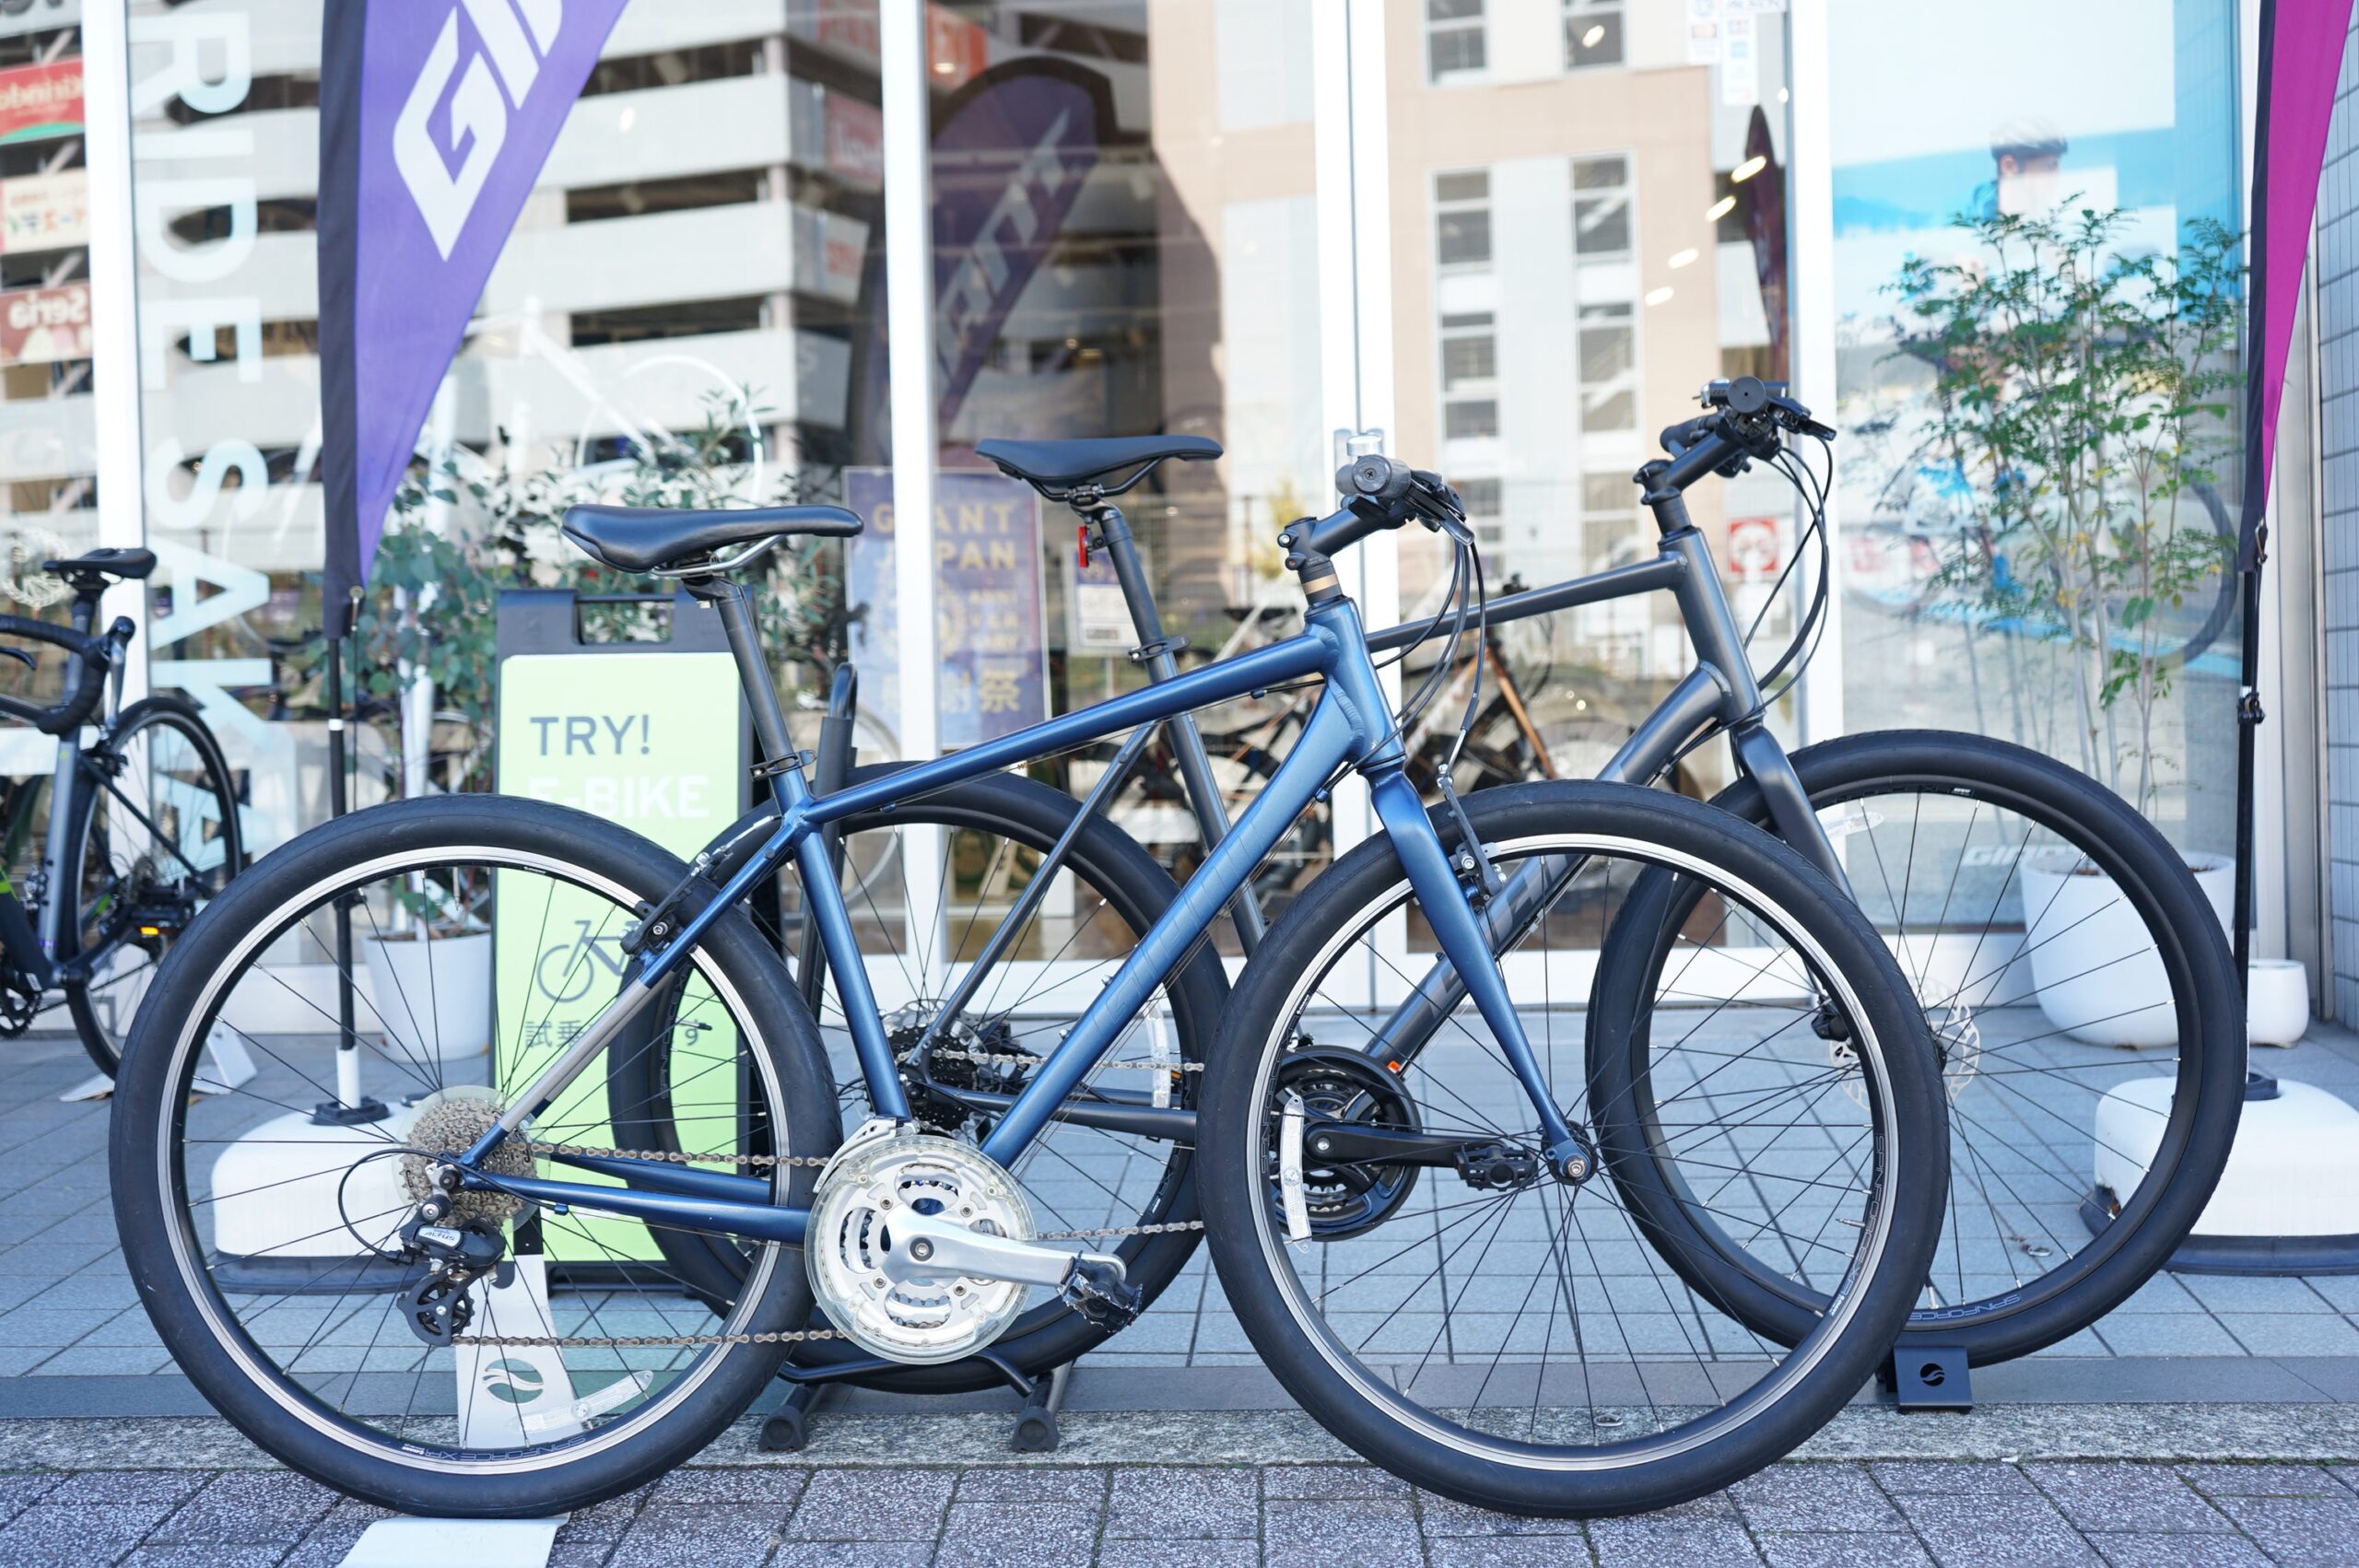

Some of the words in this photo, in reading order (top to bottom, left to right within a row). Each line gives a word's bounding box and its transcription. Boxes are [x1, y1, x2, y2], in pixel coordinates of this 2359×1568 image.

[128, 10, 263, 391] RIDE
[873, 505, 1014, 534] GANT
[875, 540, 1016, 571] JPAN
[146, 436, 276, 912] SAKA
[529, 714, 651, 755] TRY!
[424, 1232, 456, 1241] ALTUS
